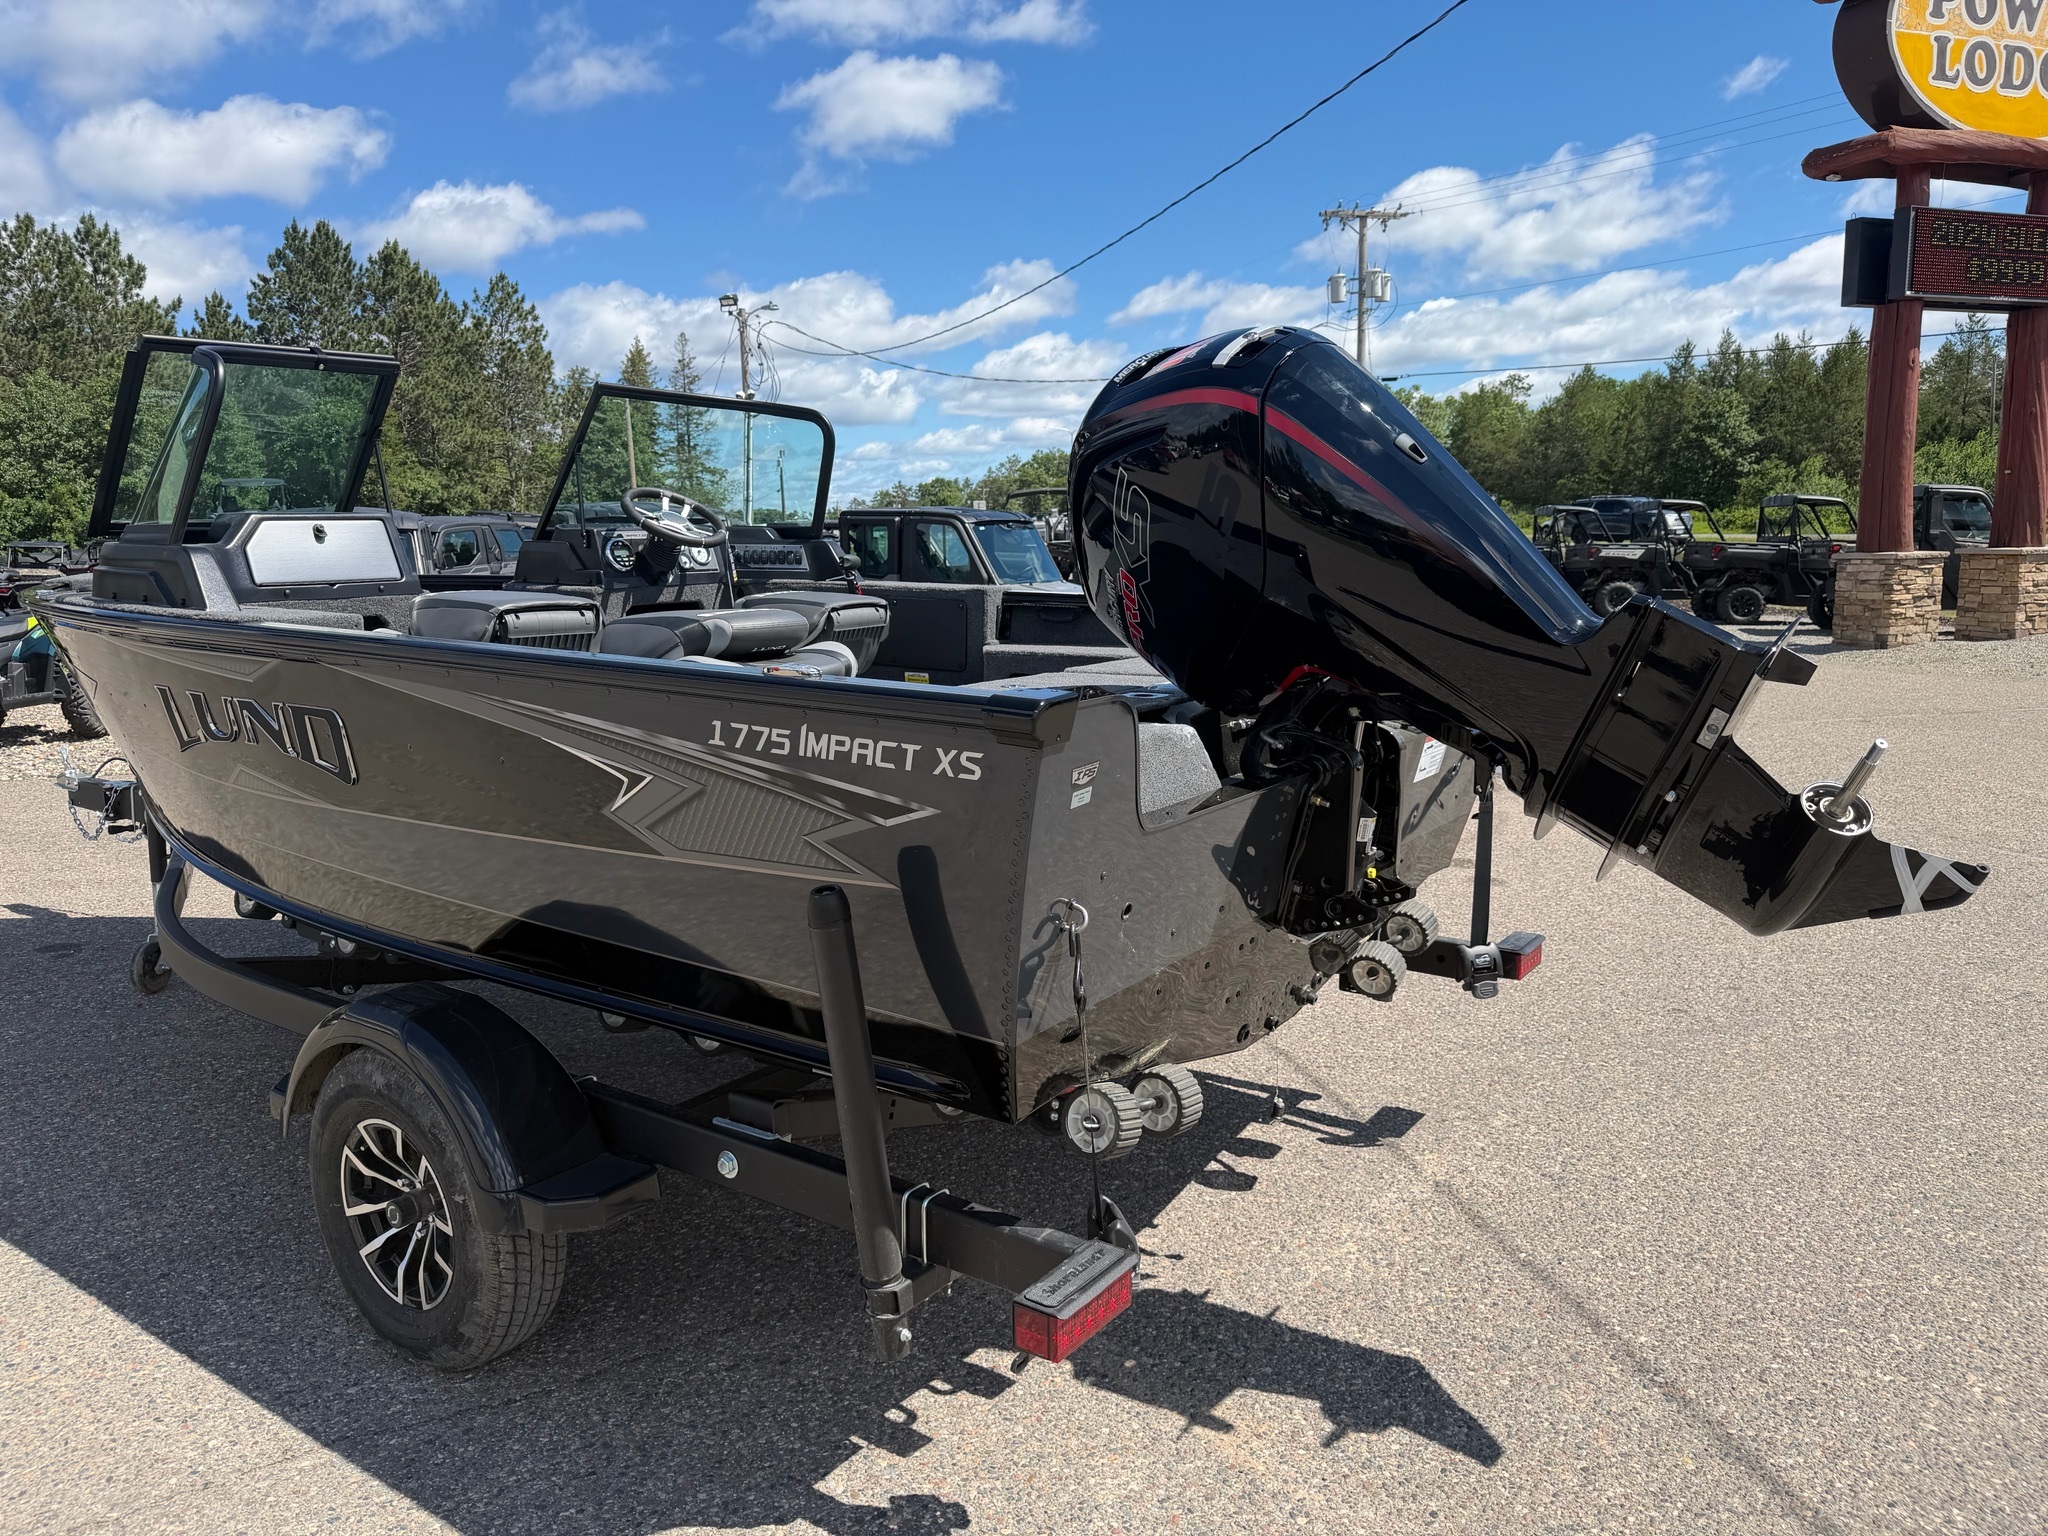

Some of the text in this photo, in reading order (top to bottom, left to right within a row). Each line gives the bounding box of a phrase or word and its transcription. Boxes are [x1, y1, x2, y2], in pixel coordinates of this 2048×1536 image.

[1931, 220, 2048, 252] 2024 SLE
[1113, 349, 1164, 383] MERCURY
[154, 684, 360, 786] LUND
[707, 719, 985, 781] 1775 IMPACT XS
[1073, 766, 1098, 783] IPS
